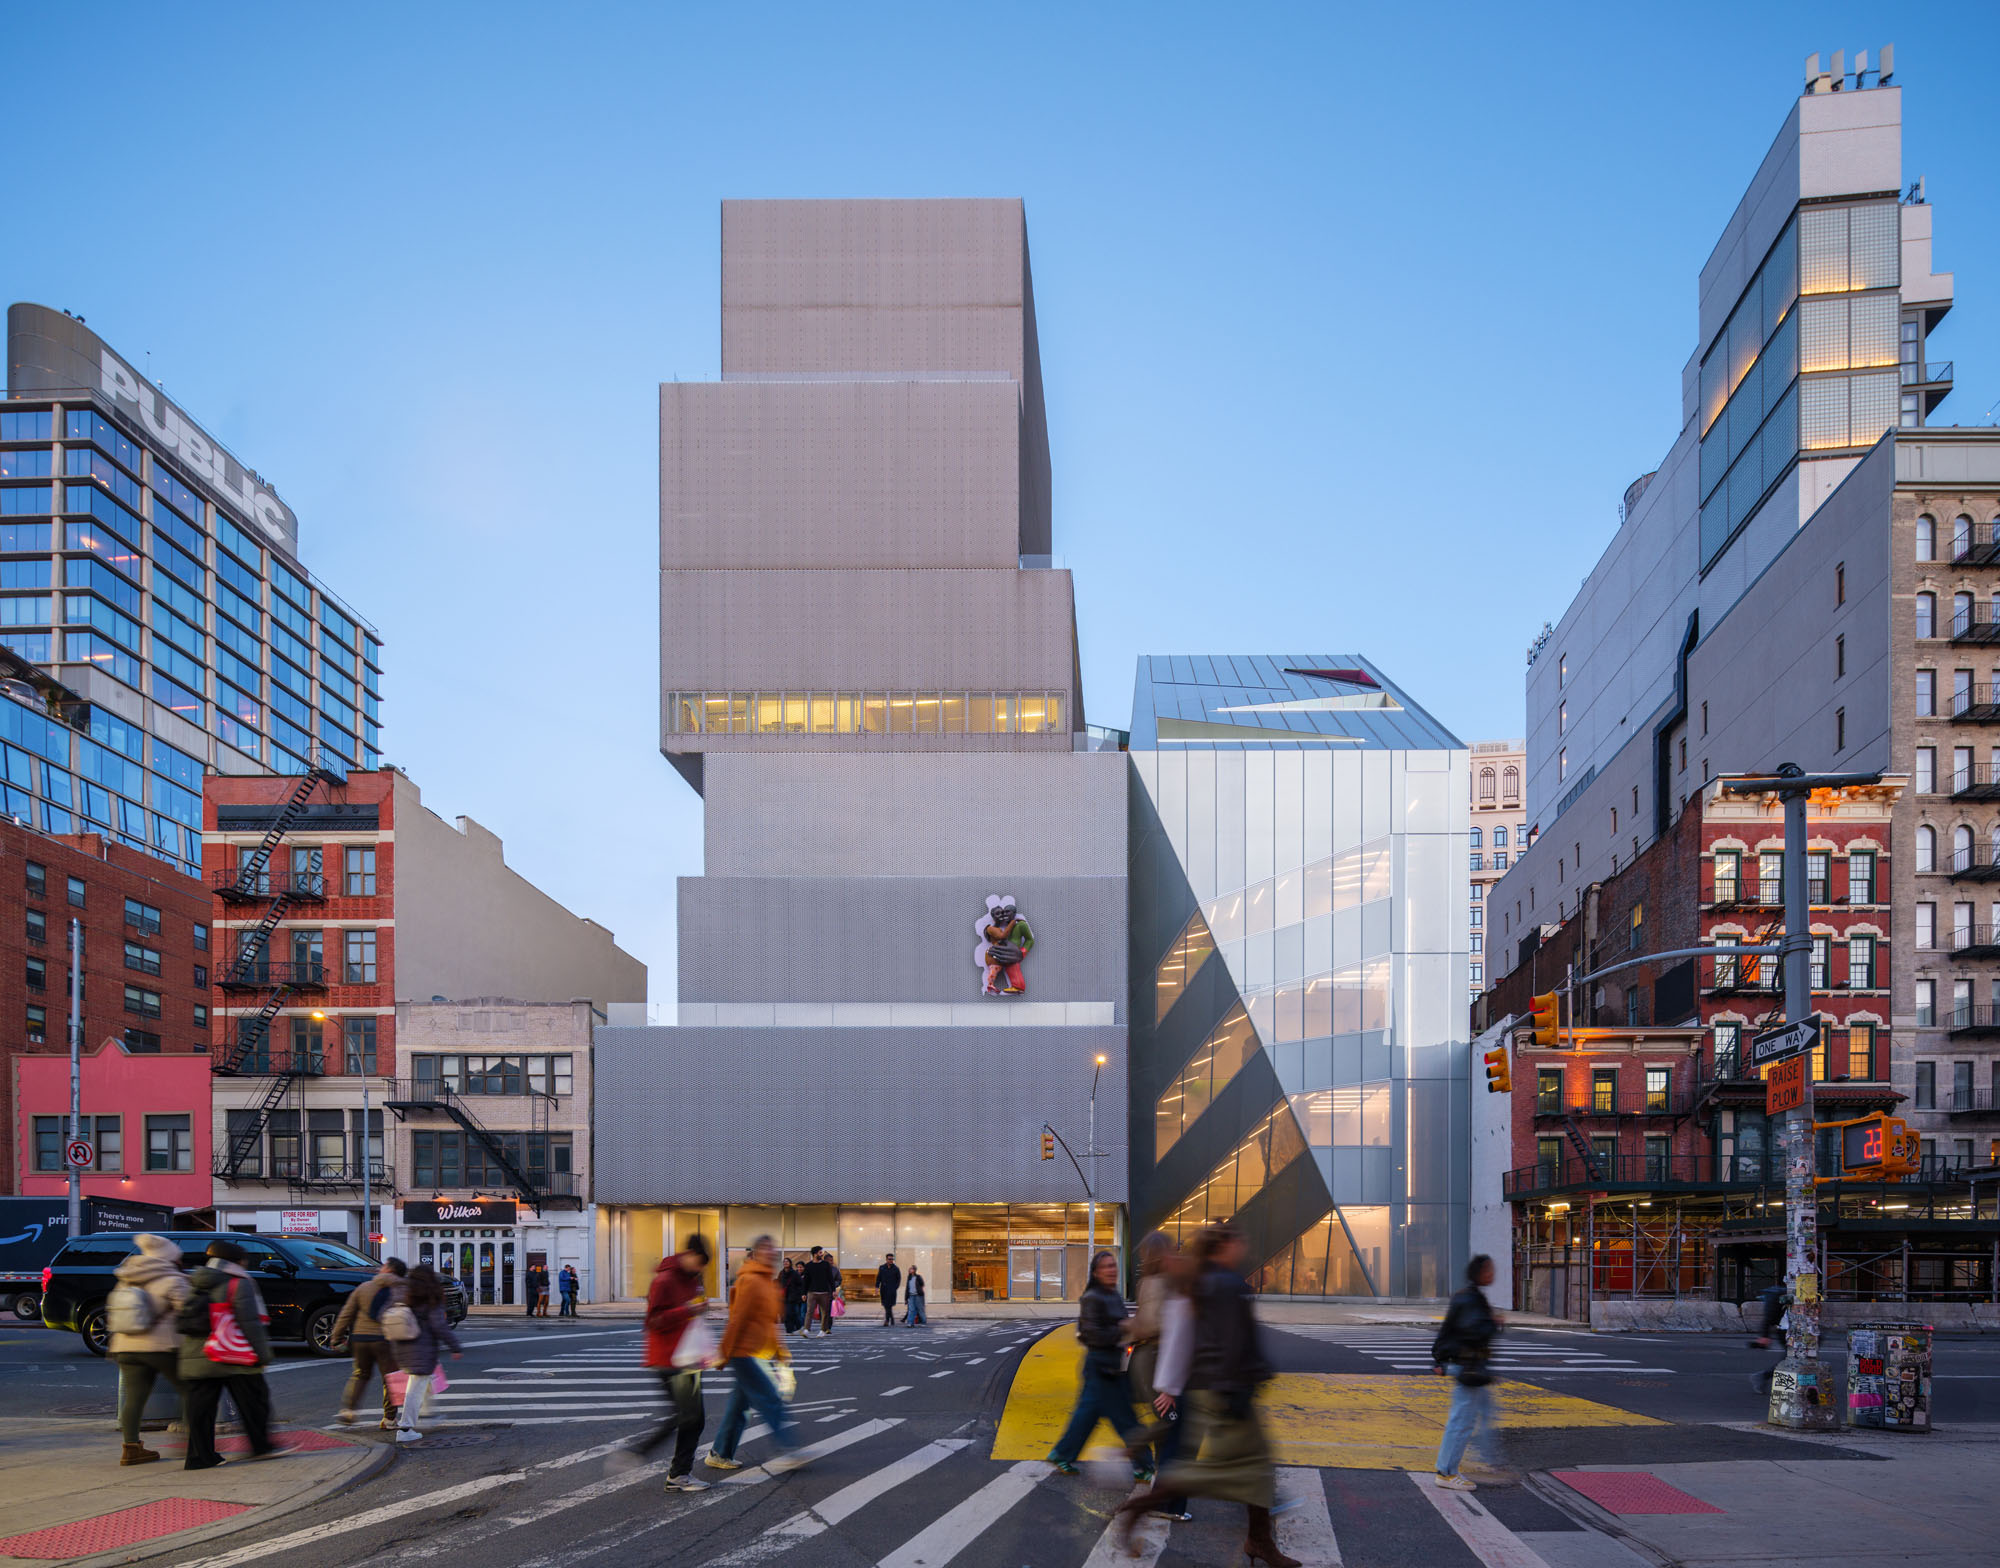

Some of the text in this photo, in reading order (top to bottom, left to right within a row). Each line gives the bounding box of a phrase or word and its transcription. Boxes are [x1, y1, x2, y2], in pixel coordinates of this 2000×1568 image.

[101, 349, 286, 540] PUBLIC
[1758, 1029, 1806, 1056] ONE WAY
[1772, 1063, 1798, 1087] RAISE
[1772, 1087, 1798, 1106] PLOW
[48, 1214, 70, 1227] pri
[98, 1211, 144, 1223] There's more
[437, 1204, 482, 1220] Wilka's
[108, 1220, 132, 1229] Prime.
